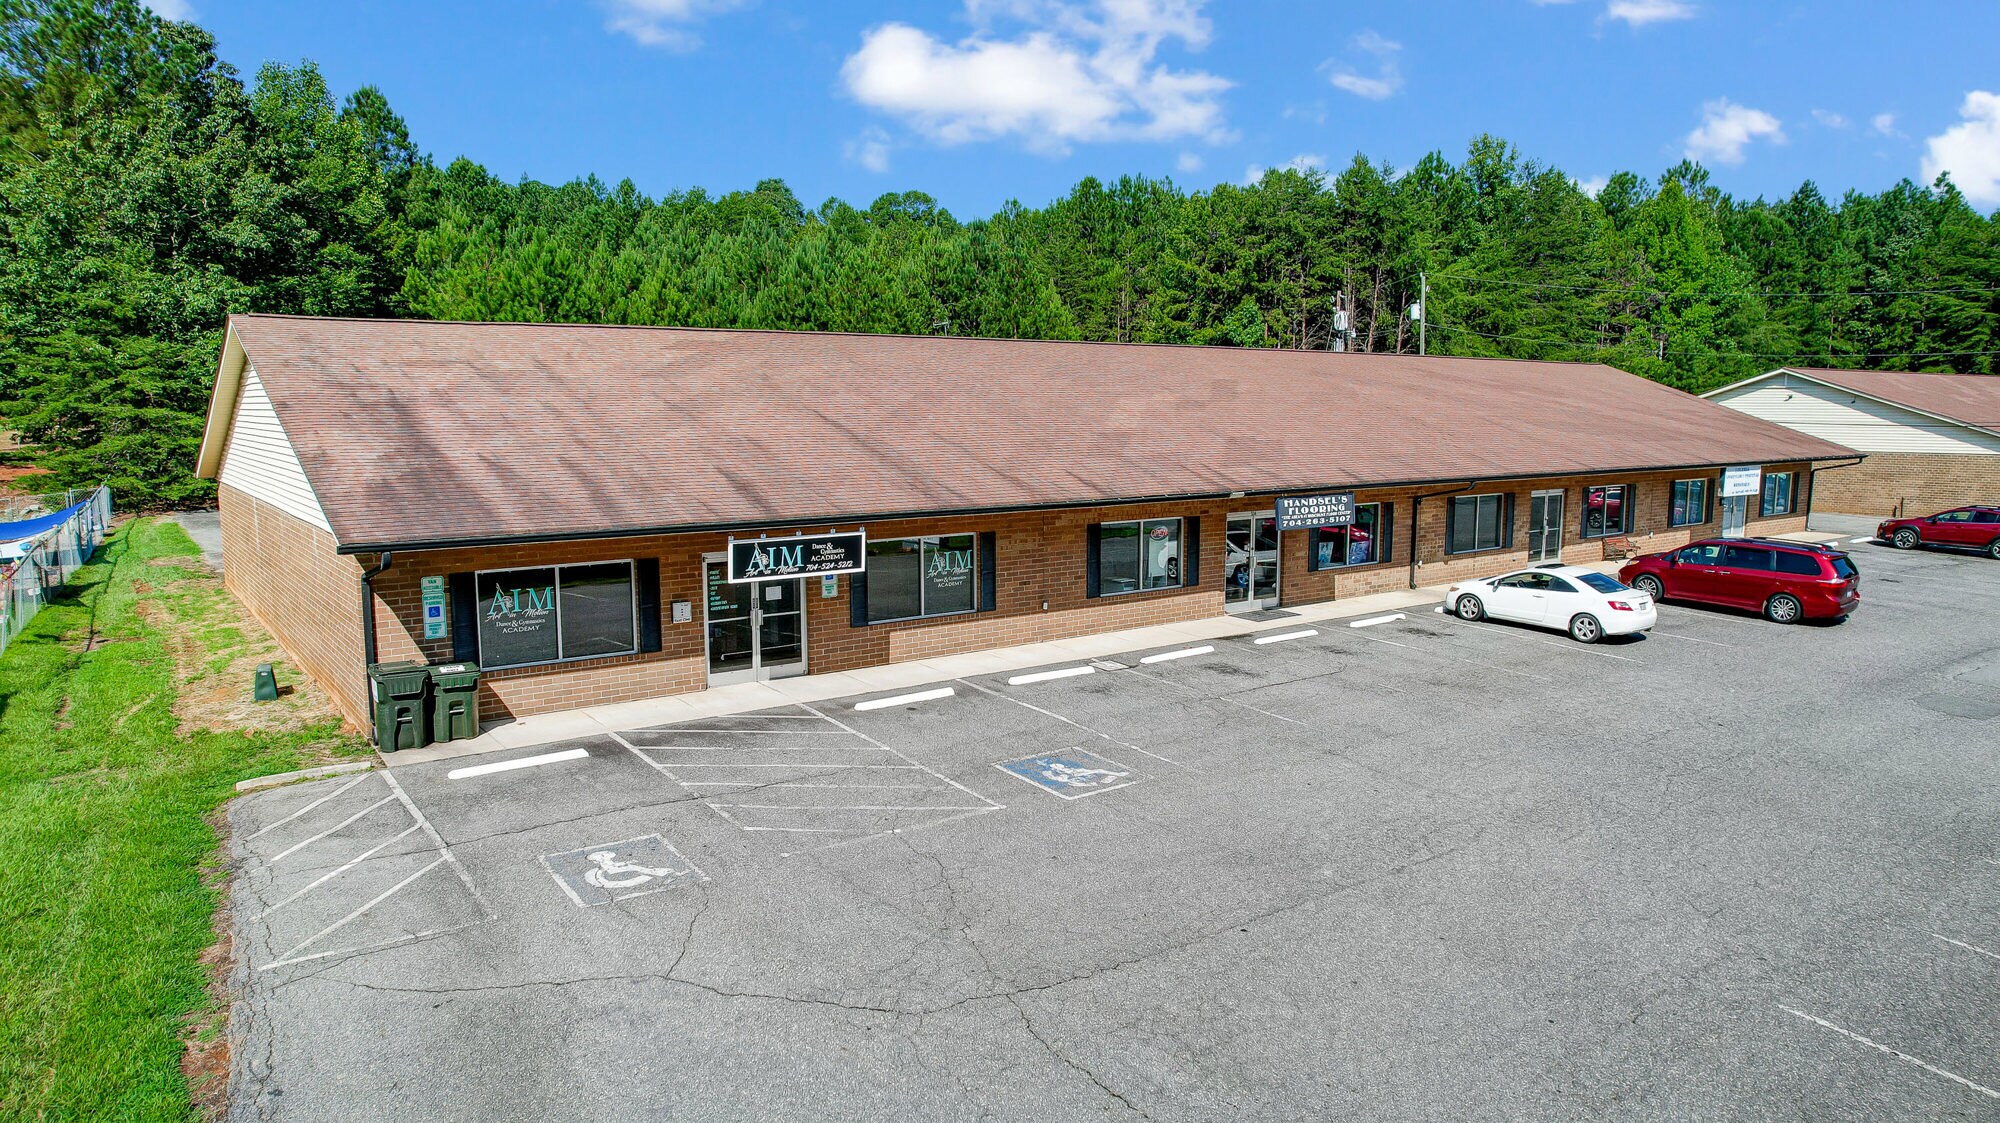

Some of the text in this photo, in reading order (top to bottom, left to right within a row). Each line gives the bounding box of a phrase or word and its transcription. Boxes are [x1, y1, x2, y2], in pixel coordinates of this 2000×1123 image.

[1284, 496, 1348, 507] HANDSEL'S
[1288, 504, 1345, 515] FLOORING
[1282, 516, 1351, 527] 704-263-5107
[745, 545, 804, 571] AIM
[810, 554, 845, 562] ACADEMY
[928, 550, 972, 572] AIM
[806, 560, 854, 571] 704-524-5212
[487, 587, 555, 615] AIM
[485, 611, 503, 622] Art
[522, 609, 549, 617] Motion
[502, 625, 540, 634] ACADEMY
[511, 620, 519, 628] &
